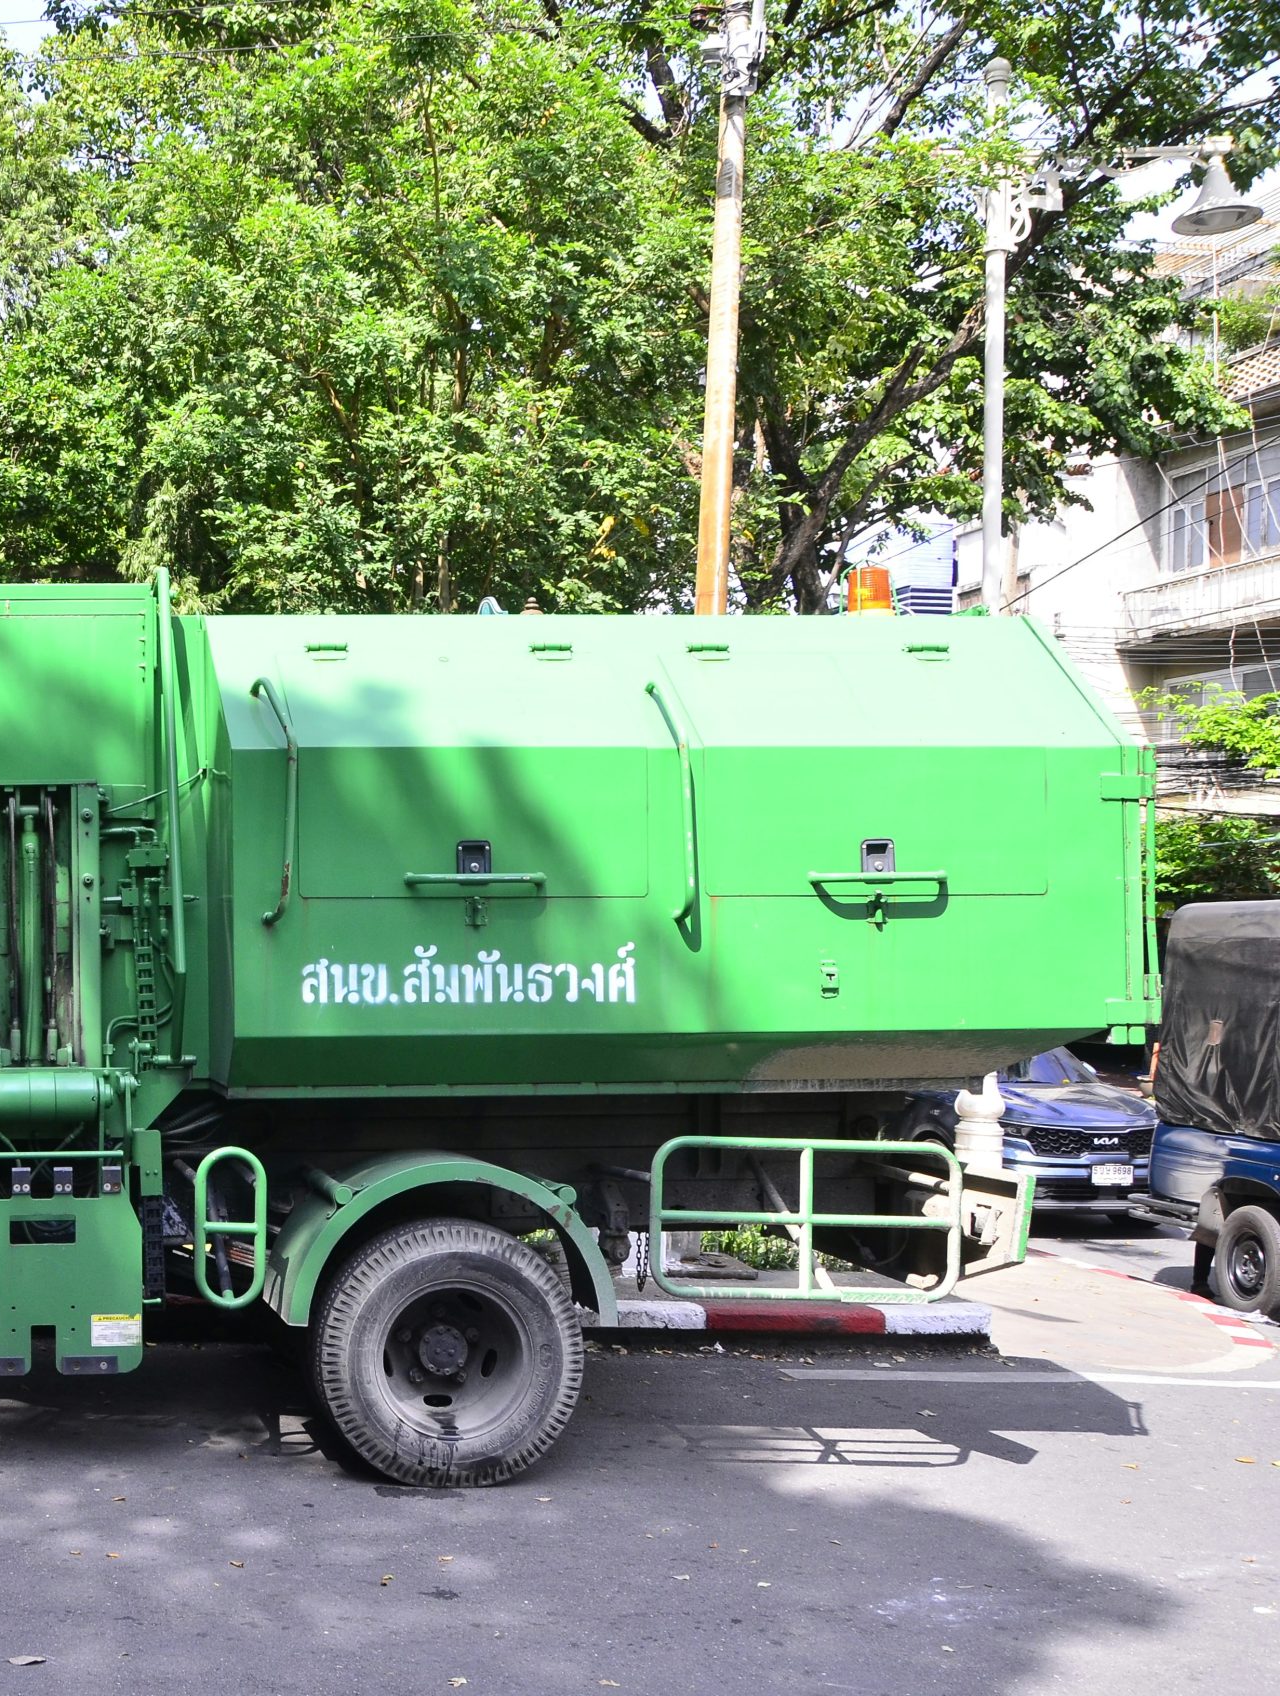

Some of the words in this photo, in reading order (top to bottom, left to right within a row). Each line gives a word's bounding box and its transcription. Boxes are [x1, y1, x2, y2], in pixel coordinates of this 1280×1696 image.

[302, 941, 636, 1004] สนข.สัมพันธวงศ์
[1093, 1137, 1119, 1145] KIA
